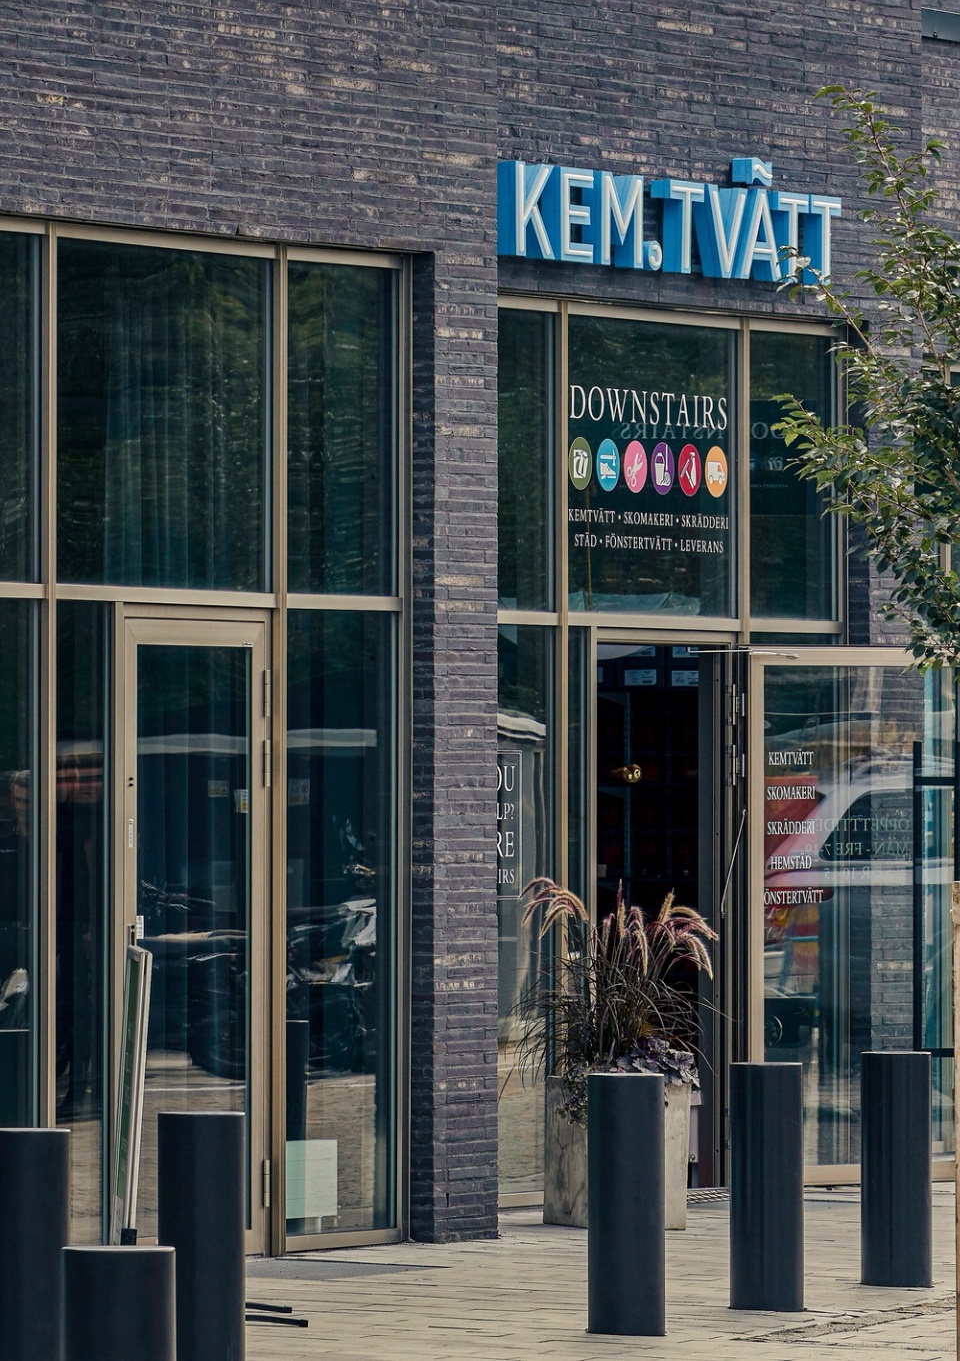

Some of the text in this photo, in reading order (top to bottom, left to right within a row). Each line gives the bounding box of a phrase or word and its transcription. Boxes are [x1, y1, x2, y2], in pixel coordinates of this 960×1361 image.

[569, 384, 728, 430] DOWNSTAIRS
[568, 508, 729, 529] KEMTVÄTT SKOMAKERI SKRÄDDERI
[574, 532, 724, 553] STÄD FÖNSTERTVÄTT LEVERANS
[768, 749, 814, 765] KEMTVÄTT
[766, 786, 816, 800] SKOMAKERI
[767, 818, 816, 835] SKRÄDDERI
[770, 853, 813, 870] HEMSTÄD
[764, 887, 824, 905] ÖNSTERTVÄTT
